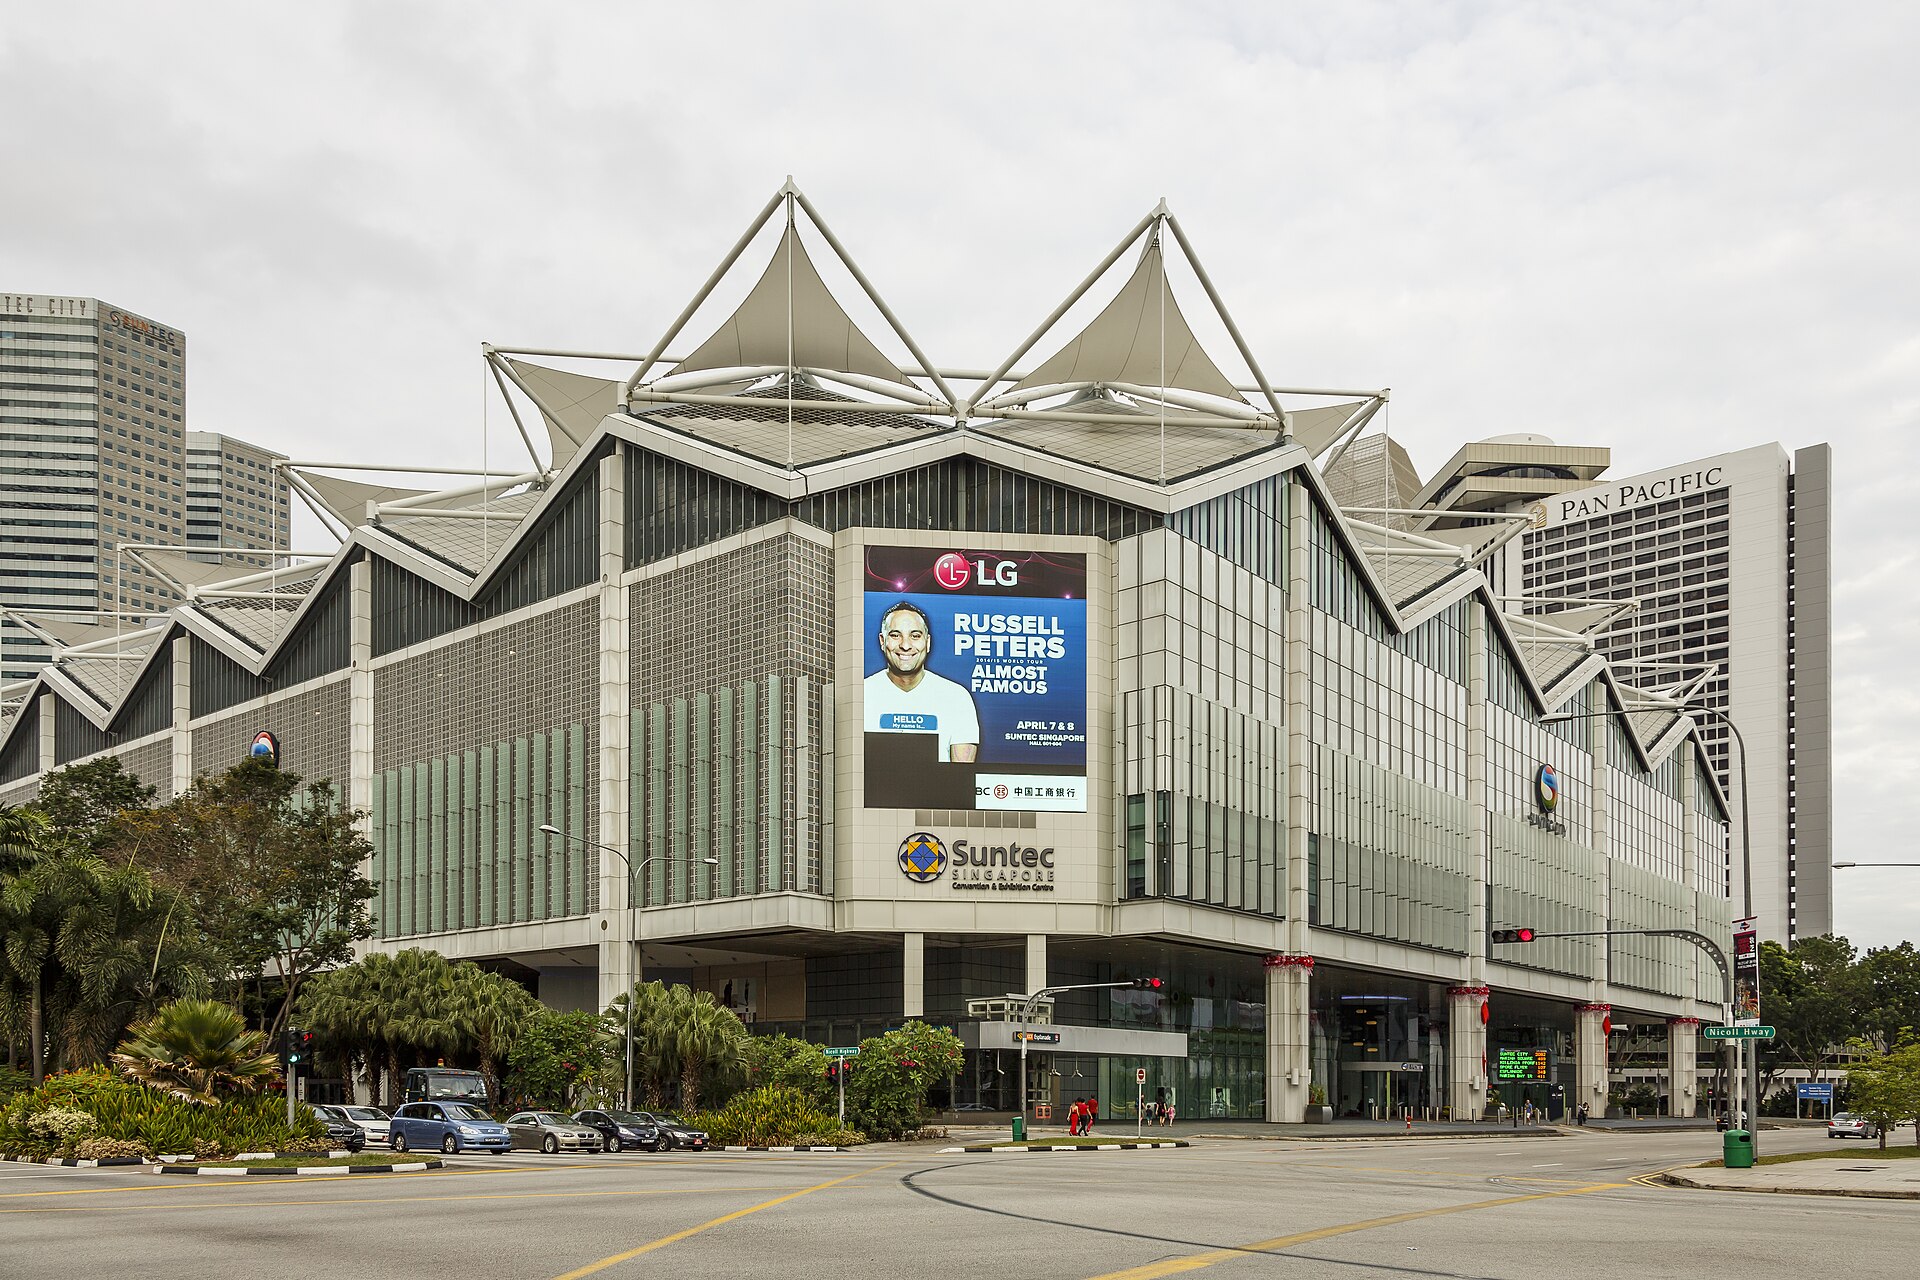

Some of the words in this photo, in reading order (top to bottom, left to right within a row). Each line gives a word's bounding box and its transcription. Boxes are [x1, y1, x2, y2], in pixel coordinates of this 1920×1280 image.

[49, 298, 86, 316] CITY
[122, 314, 175, 342] SUNTEC
[1561, 493, 1610, 521] PAN
[1619, 467, 1722, 507] PACIFIC
[978, 560, 1018, 587] LG
[954, 613, 1064, 635] RUSSELL
[954, 634, 1066, 659] PETERS
[972, 664, 1047, 680] ALMOST
[971, 679, 1048, 694] FAMOUS
[893, 715, 924, 724] HELLO
[1017, 721, 1048, 730] APRIL
[1049, 721, 1056, 730] 7
[1058, 722, 1066, 730] &
[1067, 722, 1074, 731] 8
[1005, 733, 1037, 741] SUNTEC
[1039, 733, 1085, 742] SINGAPORE
[1014, 787, 1075, 798] 中国工商银行
[952, 840, 1054, 868] Suntec
[952, 868, 1054, 882] SINGAPORE
[952, 882, 990, 891] Convention
[991, 883, 997, 891] &
[998, 883, 1031, 892] Exhibition
[1032, 883, 1054, 892] Centre
[1709, 1028, 1739, 1036] Nicoll
[1744, 1028, 1770, 1037] Hway
